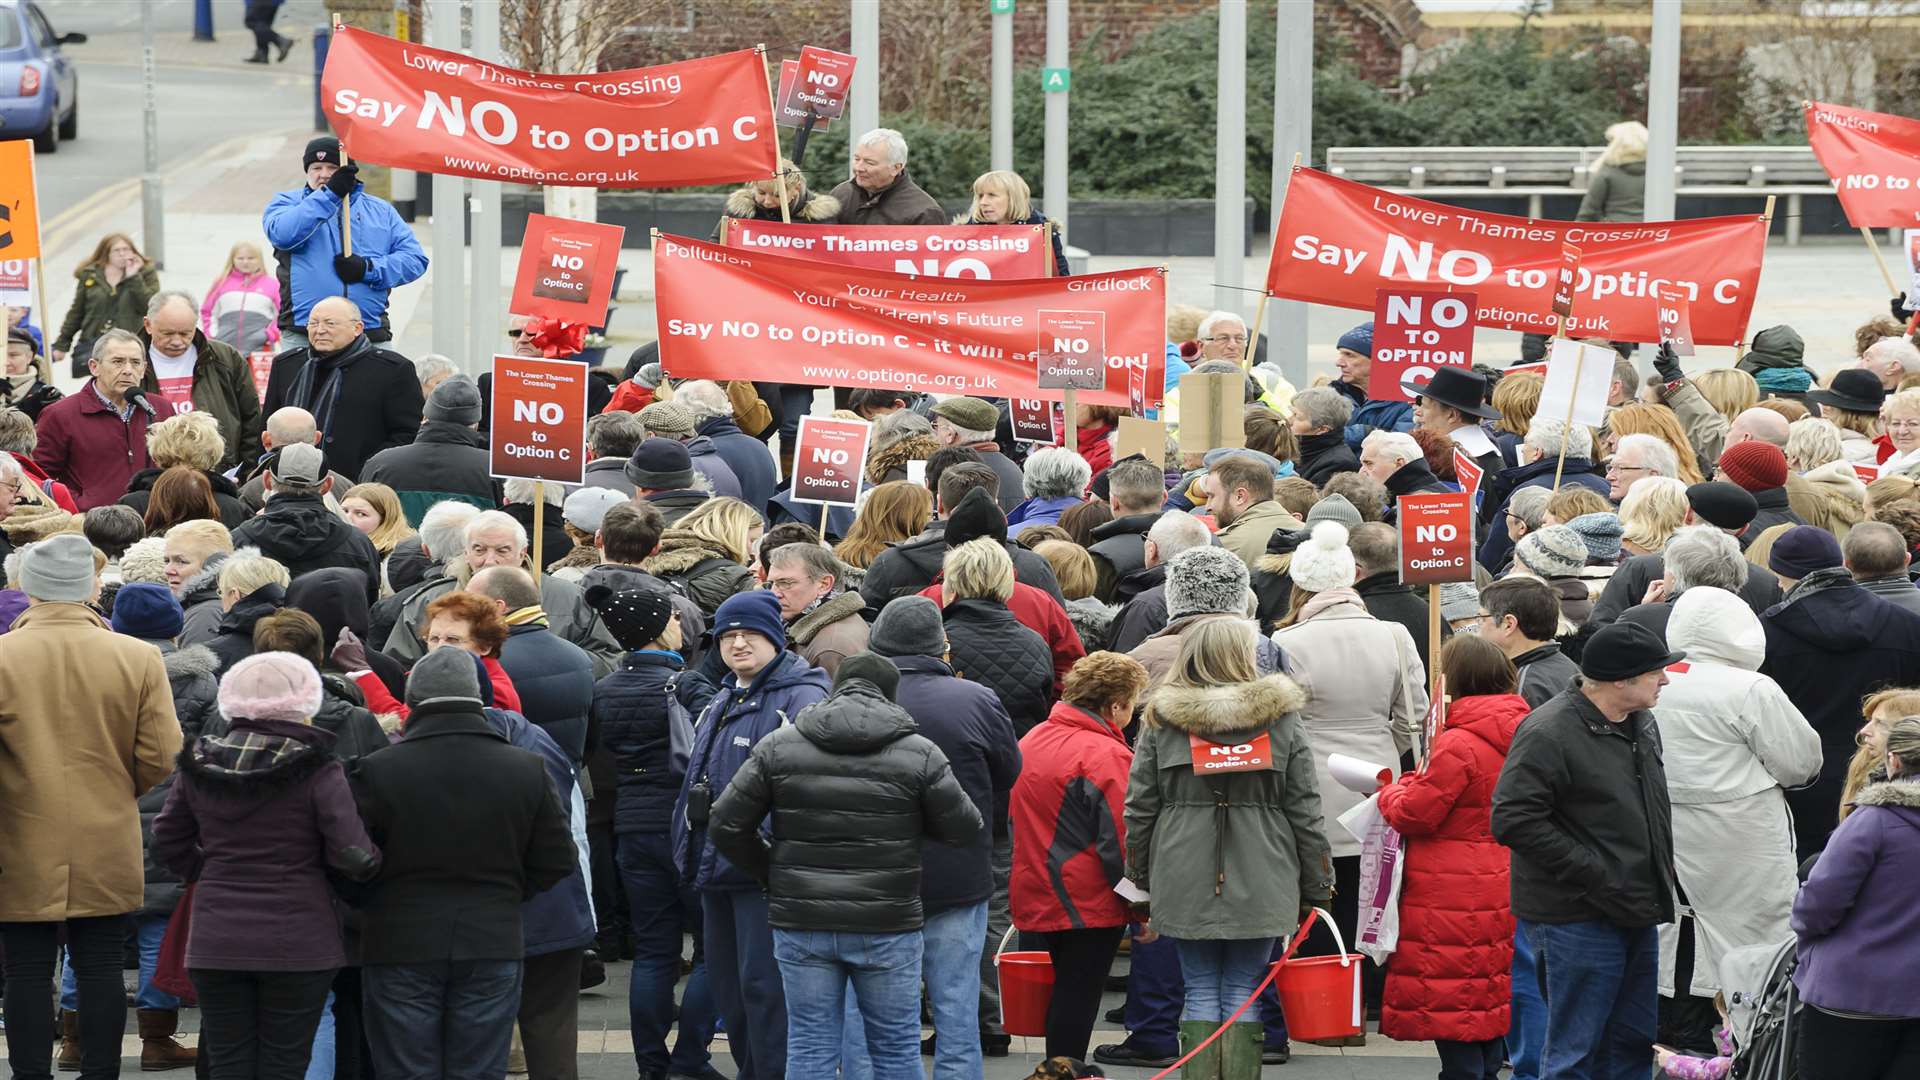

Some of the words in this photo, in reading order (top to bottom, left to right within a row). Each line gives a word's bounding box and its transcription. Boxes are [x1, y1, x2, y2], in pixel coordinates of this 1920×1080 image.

[403, 49, 469, 76] Lower
[575, 74, 681, 96] Crossing
[807, 70, 838, 87] NO
[1048, 72, 1064, 86] A
[798, 92, 826, 105] Option
[829, 98, 837, 106] C
[815, 88, 824, 96] to
[784, 106, 808, 117] Optio
[334, 89, 406, 127] Say
[416, 90, 518, 145] NO
[529, 125, 570, 150] to
[585, 125, 718, 157] Option
[732, 115, 758, 141] C
[444, 155, 639, 183] www.optionc.org.uk
[1846, 174, 1879, 190] NO
[1886, 175, 1909, 190] to
[1374, 196, 1449, 226] Lower
[1456, 214, 1556, 242] Thames
[1565, 227, 1671, 243] Crossing
[742, 230, 816, 250] Lower
[823, 235, 919, 252] Thames
[926, 235, 1030, 253] Crossing
[552, 253, 584, 270] NO
[665, 243, 751, 267] Pollution
[0, 259, 22, 276] O
[560, 271, 571, 280] to
[1291, 235, 1368, 275] Say
[1379, 233, 1493, 286] NO
[1505, 267, 1547, 289] to
[1714, 278, 1741, 305] C
[1560, 267, 1573, 285] NO
[543, 277, 573, 289] Option
[575, 282, 583, 291] C
[1067, 276, 1151, 293] Gridlock
[846, 283, 895, 299] Your
[900, 289, 966, 303] Health
[793, 290, 840, 308] Your
[848, 302, 949, 325] dren's
[957, 311, 1024, 328] Future
[1386, 295, 1468, 328] NO
[1661, 307, 1679, 324] NO
[1474, 306, 1610, 331] ptionc.og.uk
[668, 319, 712, 340] Say
[722, 320, 760, 338] NO
[768, 324, 793, 341] to
[802, 325, 886, 347] Option
[893, 335, 910, 349] C
[934, 338, 952, 354] it
[959, 343, 1003, 359] will
[1054, 338, 1089, 353] NO
[1405, 329, 1440, 345] TO
[1067, 358, 1078, 366] to
[1377, 348, 1465, 365] OPTION
[505, 369, 519, 377] The
[520, 371, 544, 380] Lower
[545, 373, 575, 382] Thames
[802, 365, 997, 390] www.optionc.org.uk
[1048, 366, 1083, 377] Option
[1086, 367, 1095, 376] C
[522, 379, 556, 389] Crossing
[514, 399, 564, 425] NO
[1020, 399, 1042, 412] NO
[1018, 420, 1040, 429] Option
[531, 430, 547, 442] to
[504, 443, 554, 459] Option
[559, 448, 570, 460] C
[812, 447, 849, 465] NO
[823, 468, 835, 477] to
[803, 476, 839, 488] Option
[841, 479, 850, 489] C
[1416, 524, 1457, 543] NO
[1432, 547, 1444, 556] to
[1410, 558, 1452, 571] Option
[1454, 557, 1464, 567] C
[1210, 743, 1253, 756] NO
[1204, 761, 1248, 769] Option
